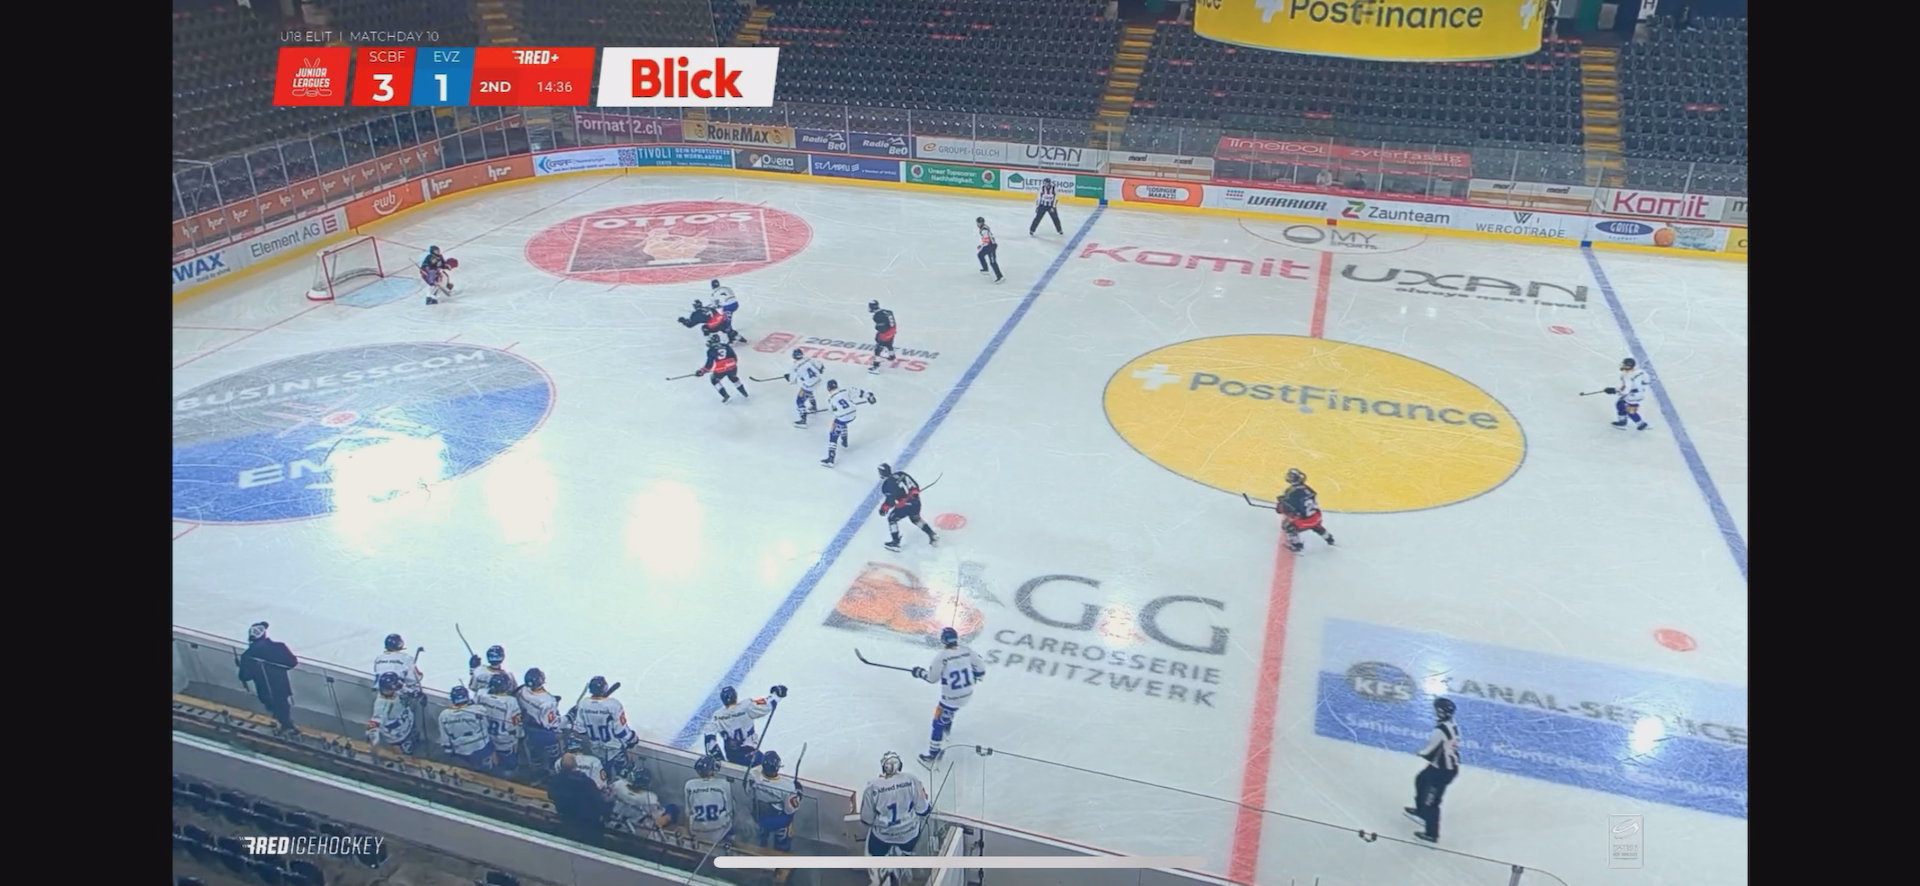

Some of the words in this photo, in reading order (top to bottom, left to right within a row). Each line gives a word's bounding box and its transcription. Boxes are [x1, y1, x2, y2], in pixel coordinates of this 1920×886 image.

[1289, 0, 1483, 30] PostFinance
[802, 135, 828, 144] Radio
[862, 139, 889, 148] Radio
[638, 147, 672, 159] TIVOLI
[1026, 145, 1082, 162] UXAN
[928, 167, 945, 175] Unser
[1026, 178, 1074, 189] LETTSHOP
[1247, 195, 1328, 211] WARRIOR
[1613, 190, 1709, 218] Komit
[593, 211, 753, 229] OTTO'S
[1368, 206, 1450, 224] Zaunteam
[1475, 223, 1566, 238] WERCOTRADE
[251, 230, 301, 258] Element
[302, 223, 321, 241] AG
[172, 252, 225, 284] WAX
[1078, 241, 1311, 281] Komit
[1340, 264, 1589, 303] UXAN
[805, 336, 856, 349] 2026
[717, 349, 728, 360] 3
[807, 367, 817, 379] 4
[838, 398, 849, 409] 9
[1189, 371, 1500, 430] PostFinance
[994, 629, 1221, 685] CARROSSERIE
[949, 668, 972, 690] 21
[985, 648, 1216, 709] SPRITZWERK
[1353, 677, 1412, 700] KFS
[587, 723, 611, 743] 10
[693, 804, 719, 822] 28
[887, 802, 901, 827] 1
